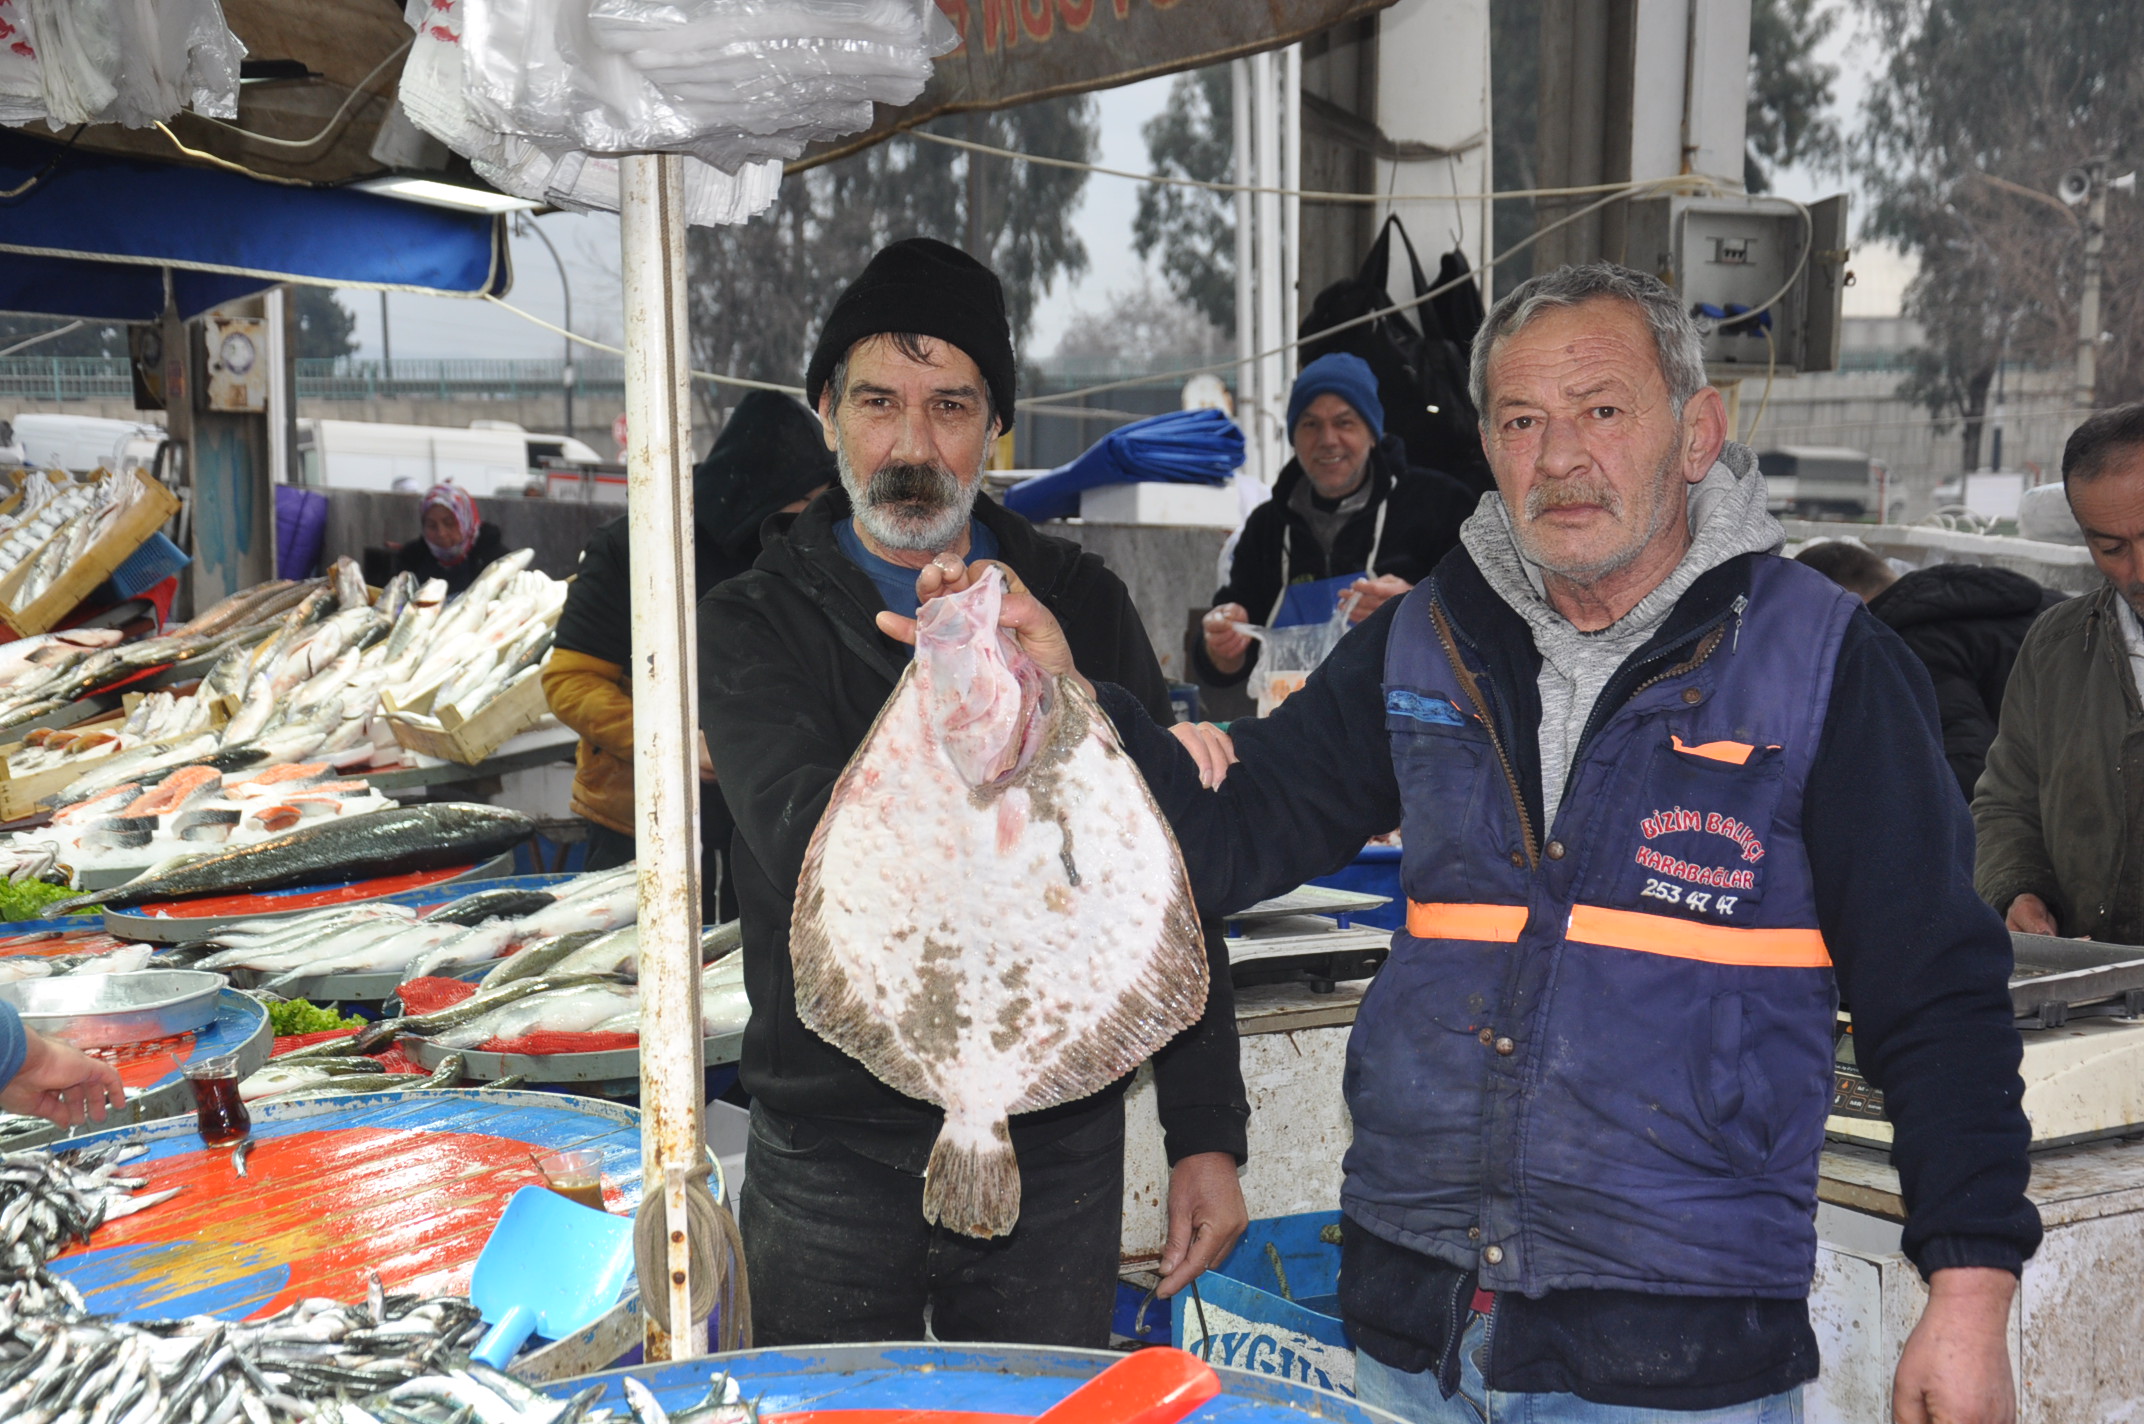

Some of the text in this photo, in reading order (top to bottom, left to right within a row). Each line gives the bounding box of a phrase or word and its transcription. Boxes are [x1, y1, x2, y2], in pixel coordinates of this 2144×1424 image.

[1640, 806, 1701, 839] BİZİM
[1635, 845, 1754, 889] KARABAĞLAR
[1640, 878, 1738, 915] 253 47 47
